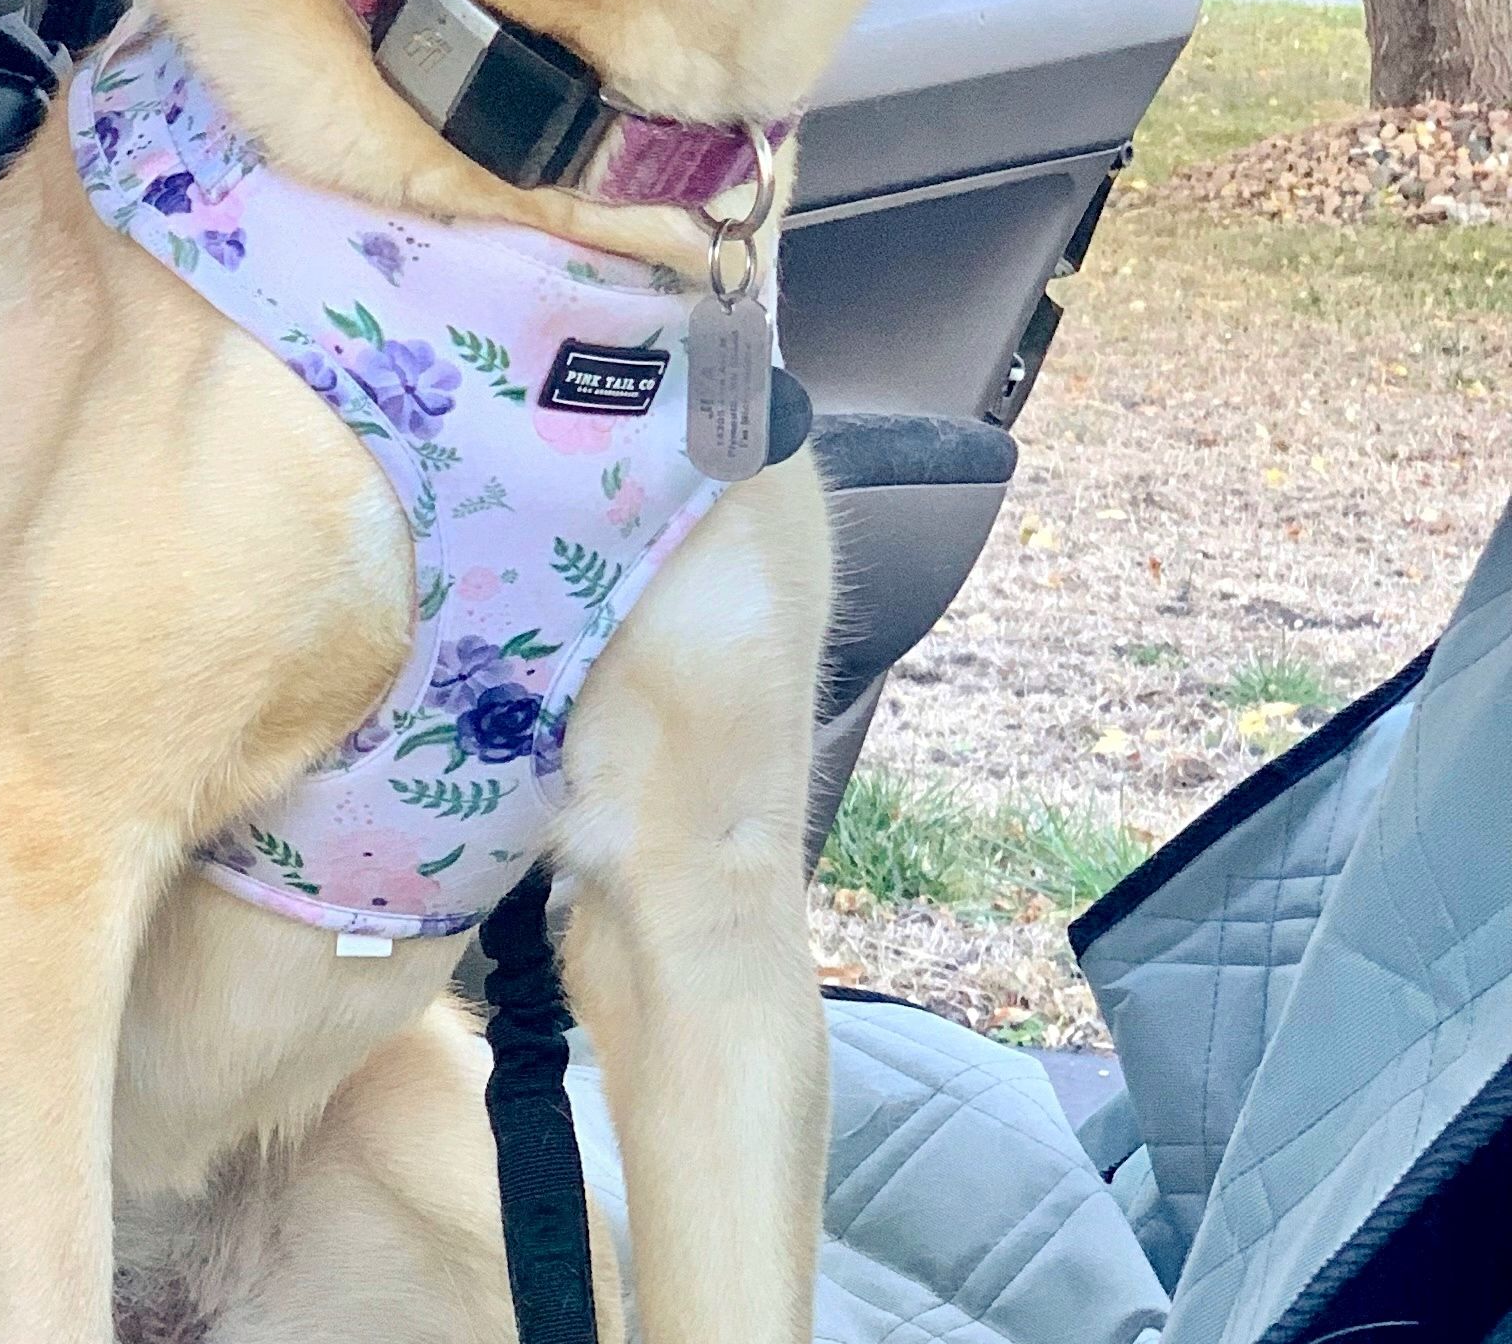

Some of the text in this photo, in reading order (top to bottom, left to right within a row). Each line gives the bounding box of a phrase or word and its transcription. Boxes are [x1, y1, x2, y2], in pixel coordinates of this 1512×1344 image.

[565, 370, 602, 388] PINK
[604, 375, 635, 391] TAIL
[638, 378, 656, 392] CO
